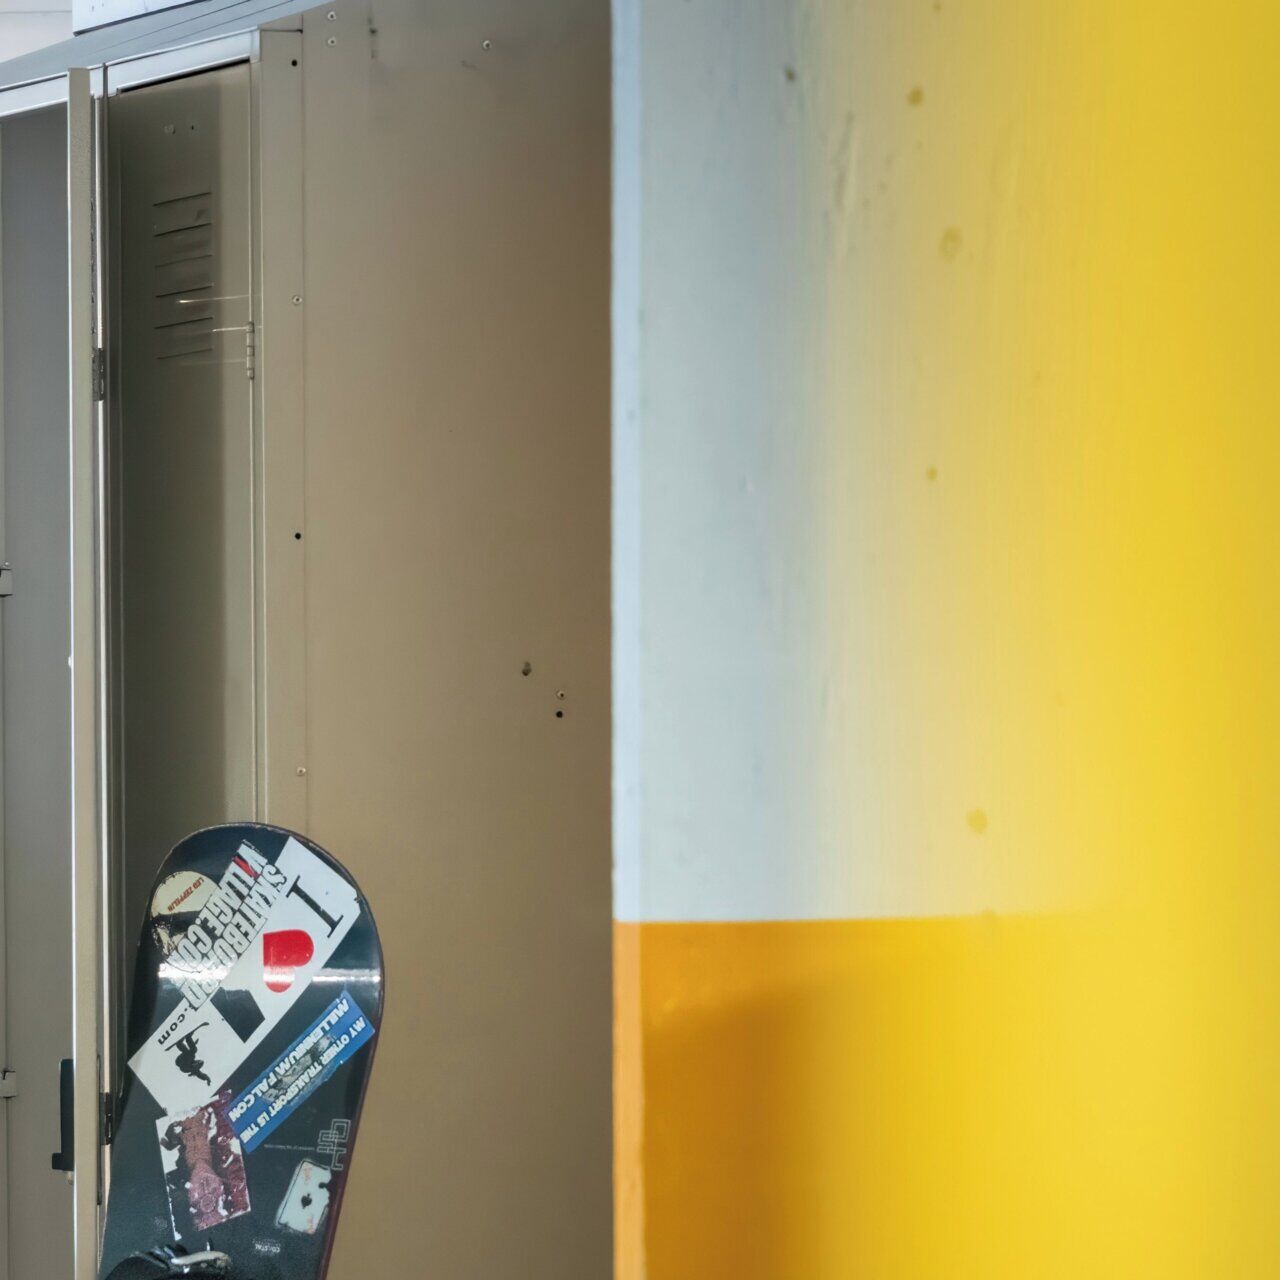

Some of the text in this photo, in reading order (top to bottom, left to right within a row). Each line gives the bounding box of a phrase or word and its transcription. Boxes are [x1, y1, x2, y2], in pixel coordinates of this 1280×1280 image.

[168, 877, 204, 912] LED ZEPPELIN
[286, 875, 344, 938] I
[181, 864, 287, 1008] SKATEBOARD
[274, 998, 350, 1075] MILLENNIUM
[319, 1034, 349, 1066] OTHER
[349, 1017, 366, 1038] MY
[228, 1071, 278, 1122] FALCON
[269, 1062, 322, 1117] TRANSPORT
